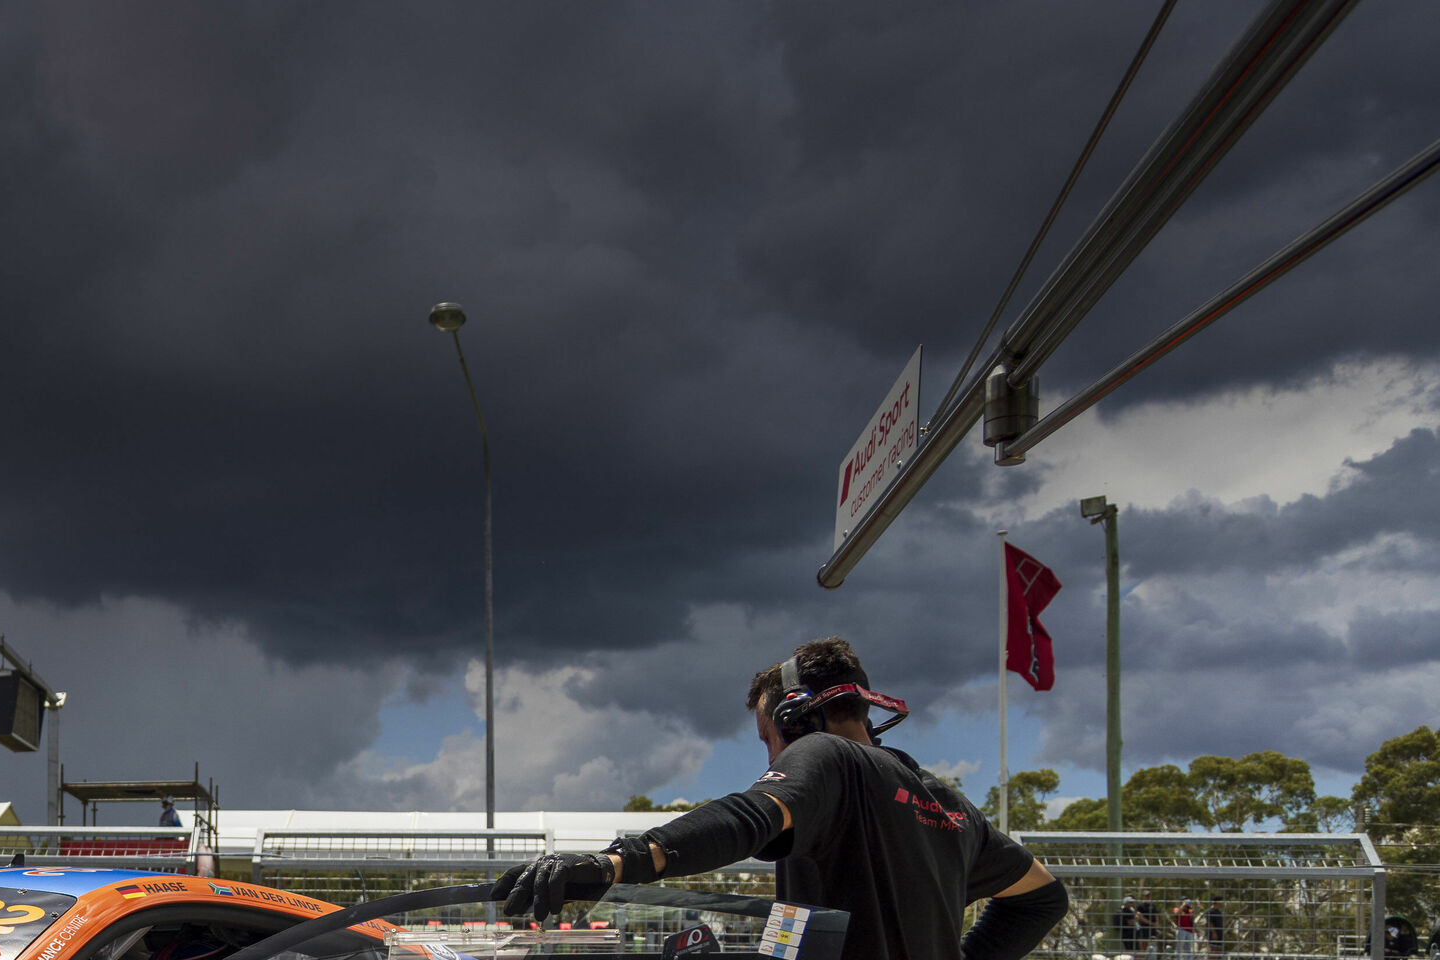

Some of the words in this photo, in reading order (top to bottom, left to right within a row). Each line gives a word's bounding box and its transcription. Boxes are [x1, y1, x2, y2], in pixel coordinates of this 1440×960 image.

[852, 425, 877, 483] Audi
[878, 380, 910, 446] Sport
[850, 457, 886, 517] customer
[887, 420, 914, 468] racing
[142, 882, 188, 894] HAASE
[232, 886, 258, 899] VAN
[259, 890, 285, 904] DER
[286, 896, 323, 913] LINDE
[60, 914, 88, 941] CENTRE
